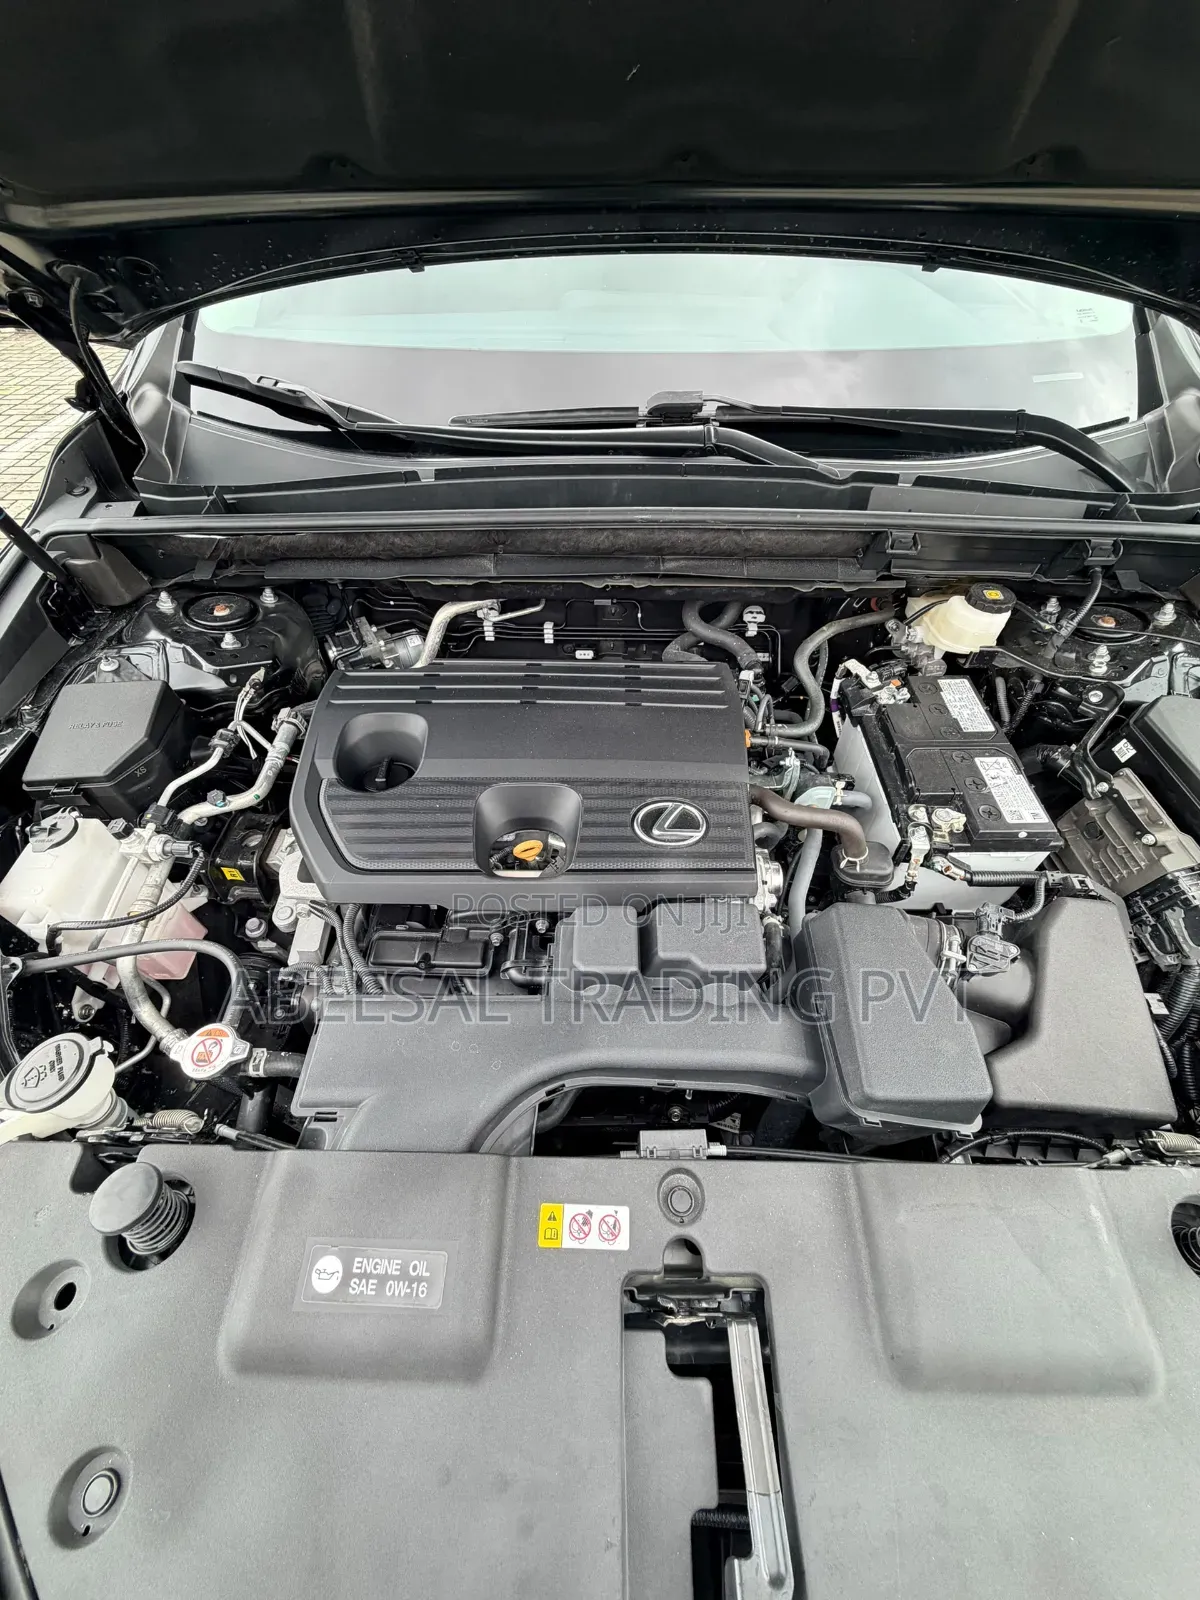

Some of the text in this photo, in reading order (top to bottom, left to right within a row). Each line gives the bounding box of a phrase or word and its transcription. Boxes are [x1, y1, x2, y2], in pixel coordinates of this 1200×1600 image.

[352, 1257, 431, 1277] ENGINE OIL
[348, 1278, 428, 1298] SAE 0W-16
